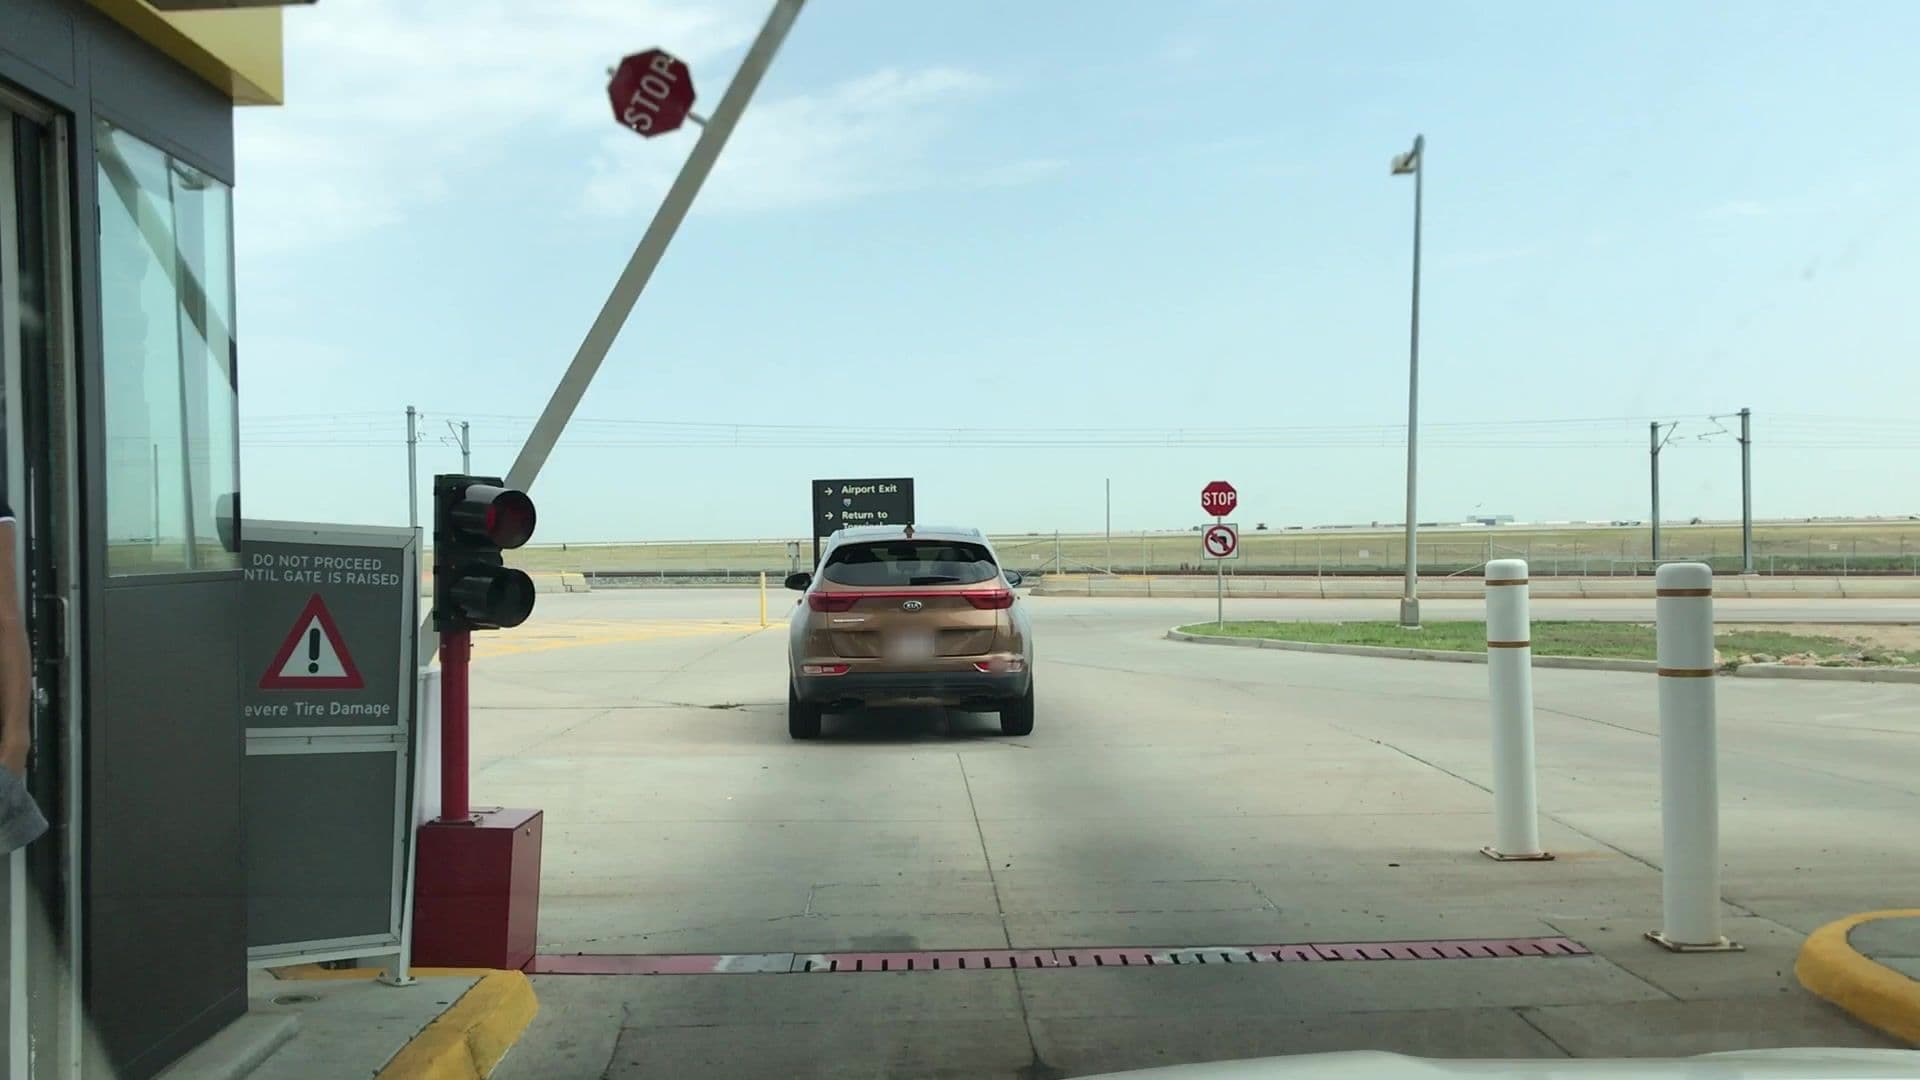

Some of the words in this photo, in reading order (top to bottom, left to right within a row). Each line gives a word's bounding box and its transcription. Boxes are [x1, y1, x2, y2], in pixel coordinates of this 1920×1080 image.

[623, 56, 677, 131] STOP
[841, 485, 875, 496] Airport
[879, 484, 897, 493] Exit
[1203, 492, 1235, 506] STOP
[842, 511, 874, 520] Return
[877, 511, 888, 519] to
[253, 553, 274, 567] DO
[279, 555, 309, 568] NOT
[314, 556, 382, 571] PROCEED
[244, 568, 279, 581] NTIL
[283, 569, 322, 583] GATE
[328, 571, 342, 584] IS
[346, 572, 400, 586] RAISED
[245, 704, 288, 717] evere
[295, 701, 324, 716] Tire
[330, 701, 390, 718] Damage
